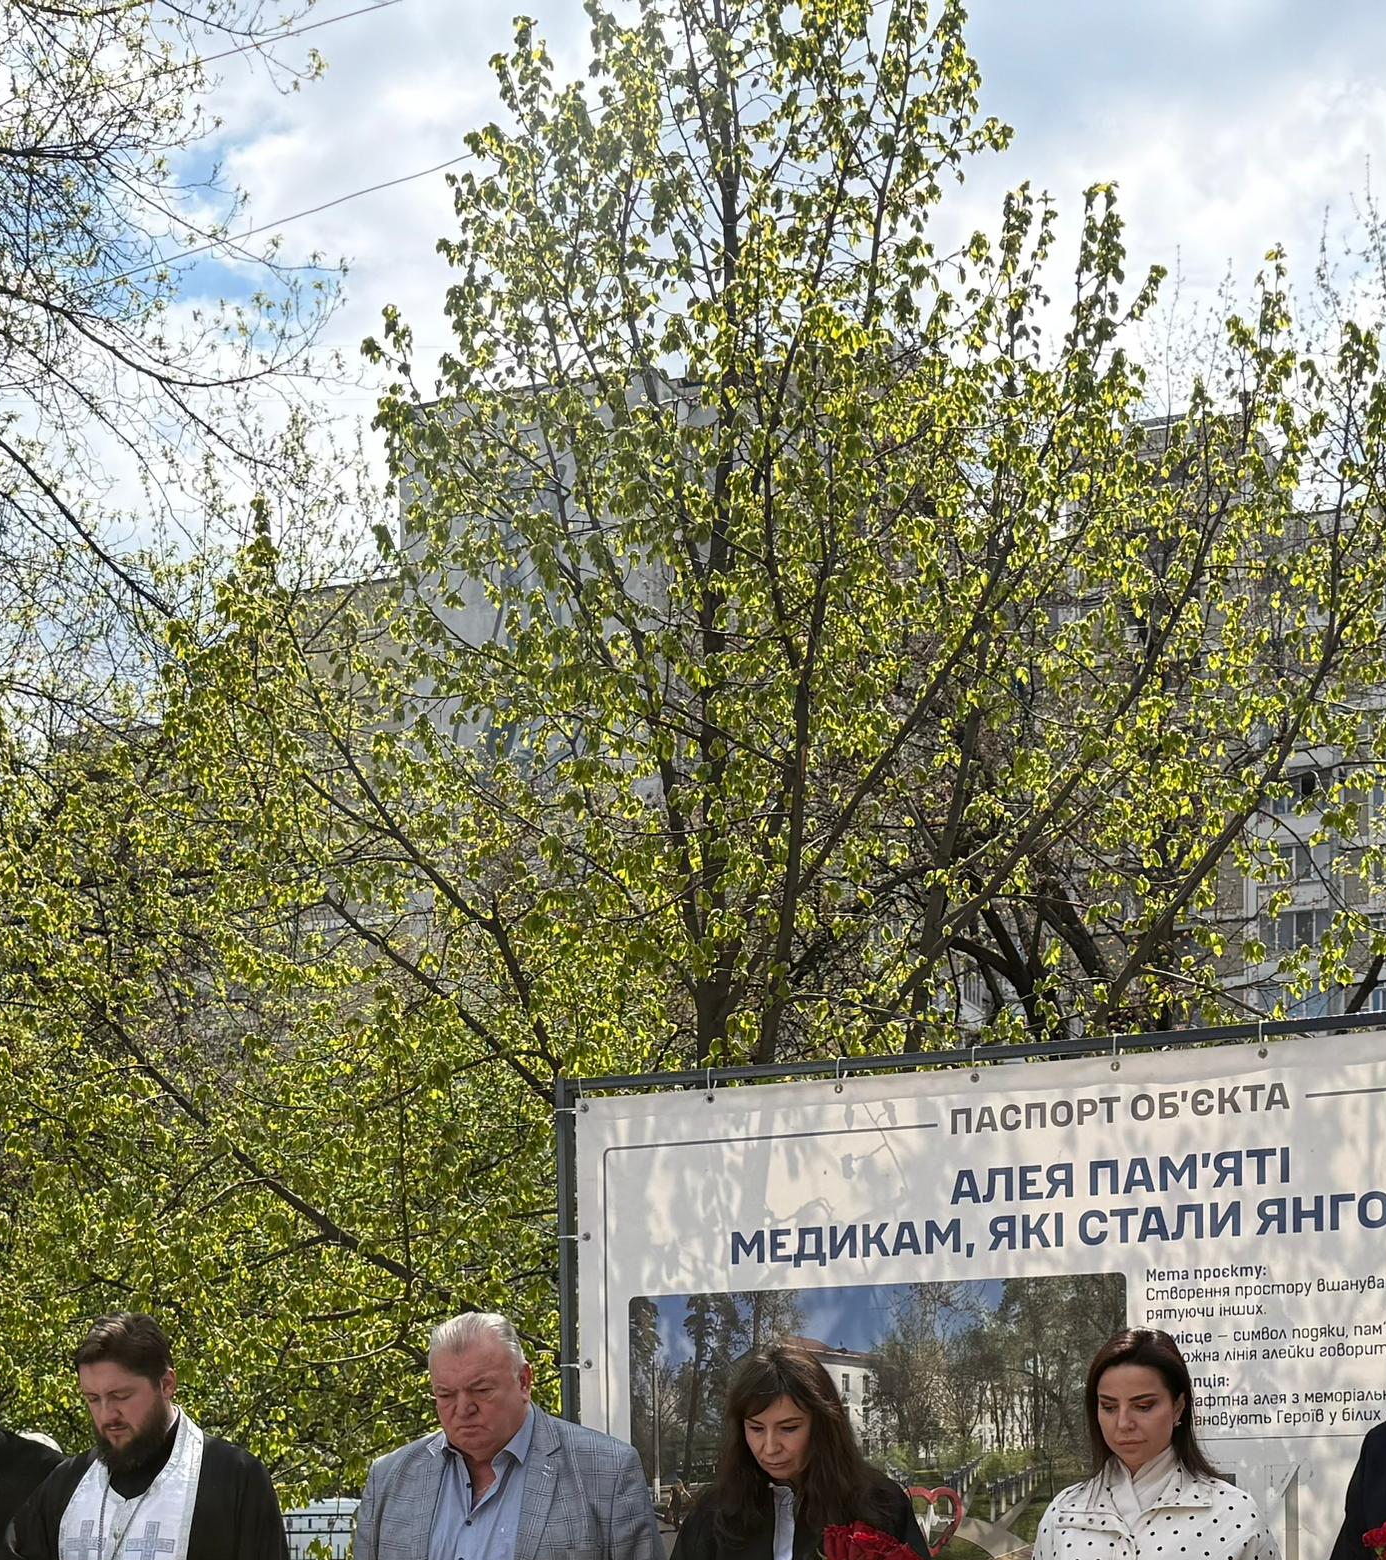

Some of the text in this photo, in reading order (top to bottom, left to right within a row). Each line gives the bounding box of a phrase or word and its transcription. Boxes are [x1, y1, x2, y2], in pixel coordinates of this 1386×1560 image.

[950, 1082, 1291, 1135] ПАСПОРТ ОБ'ЄКТА
[950, 1147, 1290, 1205] АЛЕЯ ПАМ'ЯТІ
[731, 1218, 975, 1268] МЕДИКАМ,
[988, 1212, 1063, 1251] ЯКІ
[1078, 1201, 1241, 1246] СТАЛИ
[1146, 1264, 1267, 1282] Мета проєкту:
[1146, 1285, 1230, 1302] Створення
[1235, 1281, 1312, 1298] простору
[1146, 1303, 1267, 1323] рятуючи інших.
[1233, 1326, 1287, 1342] символ
[1292, 1323, 1349, 1342] подяки,
[1181, 1349, 1220, 1363] ожна
[1224, 1347, 1257, 1361] лінія
[1262, 1344, 1314, 1360] алейки
[1194, 1393, 1249, 1410] афтна
[1253, 1393, 1287, 1405] алея
[1291, 1392, 1300, 1403] з
[1194, 1412, 1272, 1428] ановують
[1277, 1408, 1324, 1426] Героїв
[1329, 1411, 1337, 1425] у
[1342, 1407, 1381, 1421] білих
